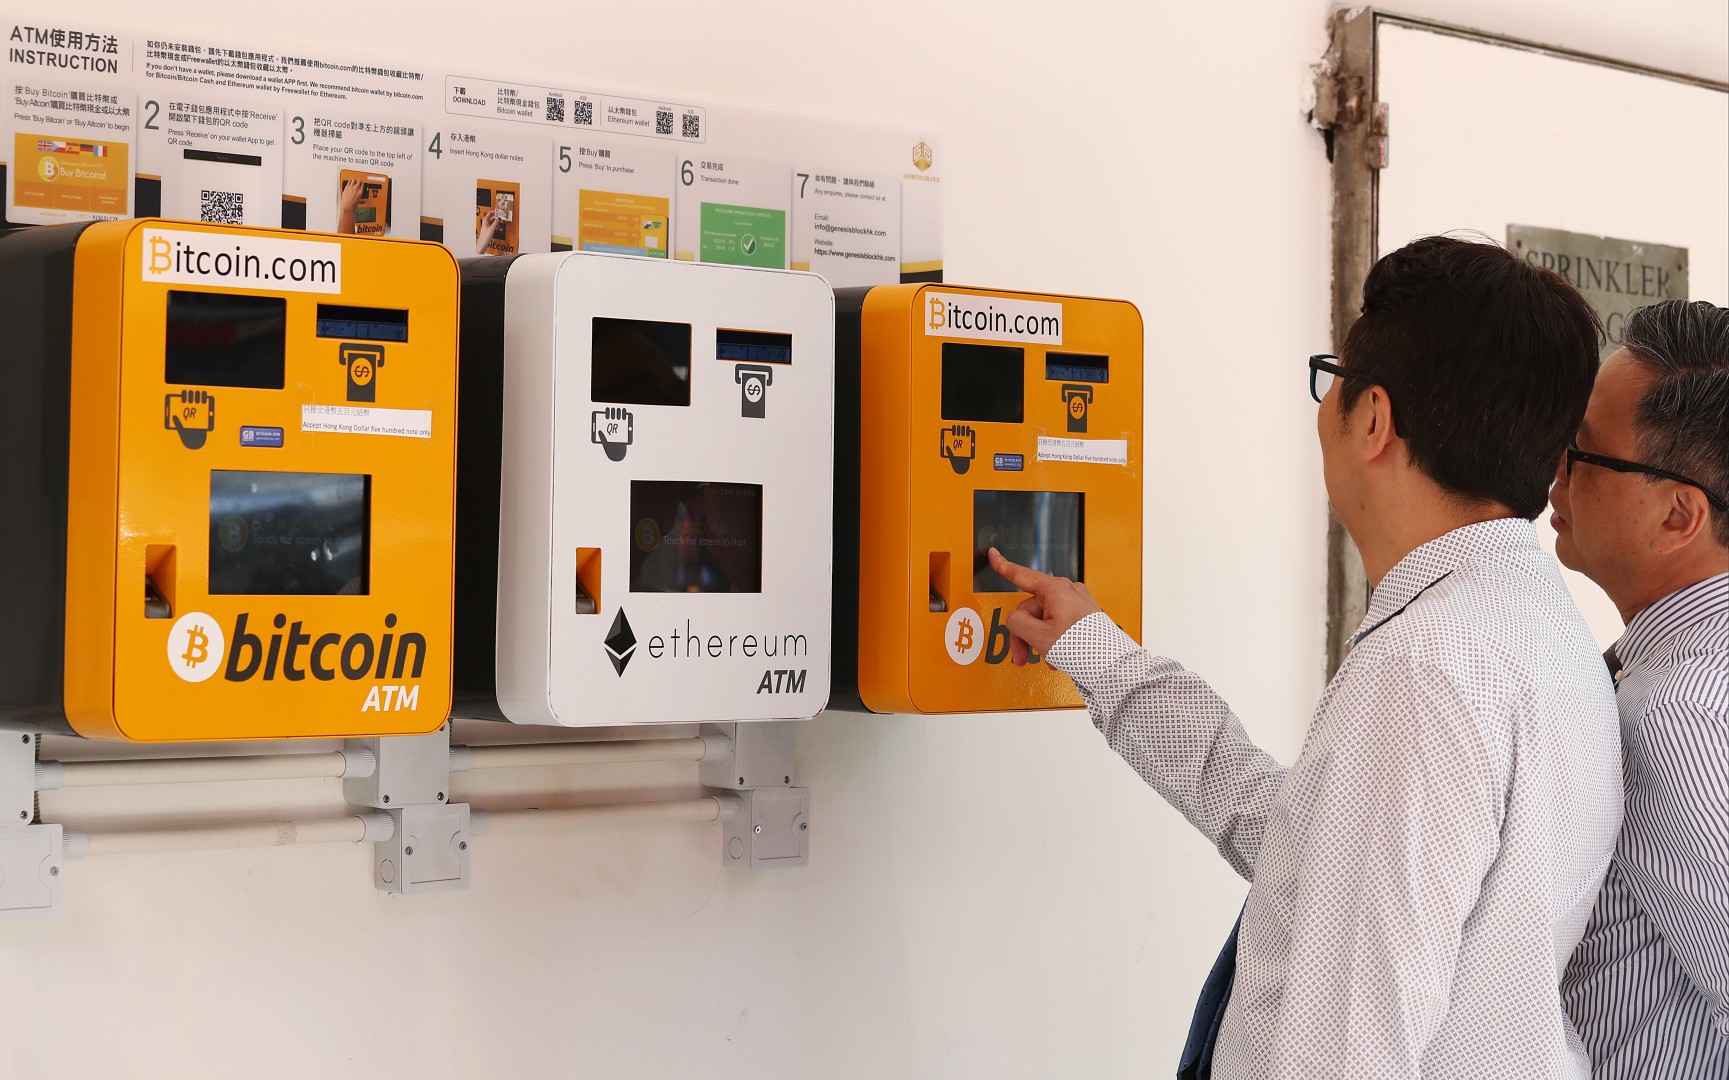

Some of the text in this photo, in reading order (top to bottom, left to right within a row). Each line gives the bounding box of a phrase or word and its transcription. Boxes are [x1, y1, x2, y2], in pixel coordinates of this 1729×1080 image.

[10, 26, 118, 54] ATM使用方法
[10, 48, 118, 73] INSTRUCTION
[217, 70, 234, 79] please
[236, 72, 262, 81] download
[320, 83, 350, 92] recommend
[394, 91, 423, 100] bitcoin.com
[228, 80, 255, 89] Ethereum
[282, 86, 310, 95] Freewallet
[320, 91, 347, 100] Ethereum.
[454, 86, 466, 95] 下載
[453, 96, 486, 106] DOWNLOAD
[145, 100, 160, 130] 2
[608, 116, 634, 125] Ethereum
[168, 128, 183, 136] Press
[185, 130, 209, 139] 'Receive'
[248, 136, 258, 144] App
[291, 116, 305, 144] 3
[428, 132, 442, 159] 4
[450, 133, 476, 143] 存入港幣
[323, 154, 347, 163] machine
[466, 149, 479, 158] Hong
[559, 146, 571, 173] 5
[60, 167, 73, 178] Buy
[681, 160, 694, 186] 6
[701, 162, 723, 171] 交易完成
[700, 175, 726, 184] Transaction
[797, 173, 809, 198] 7
[357, 224, 382, 234] bitcoin
[814, 223, 886, 236] info@genesisblockhk.com
[148, 236, 336, 284] Bitcoin.com
[814, 248, 896, 262] https://www.genesisblockhk.com
[929, 298, 1059, 336] Bitcoin.com
[183, 407, 197, 420] QR
[303, 421, 321, 430] Accept
[323, 423, 337, 431] Hong
[339, 424, 352, 432] Kong
[606, 423, 618, 435] QR
[953, 439, 963, 450] QR
[663, 536, 684, 545] Touch
[686, 536, 697, 545] the
[732, 538, 746, 546] start
[648, 618, 807, 658] ethereum
[225, 612, 427, 682] bitcoin
[756, 670, 807, 694] ATM
[361, 685, 419, 712] ATM
